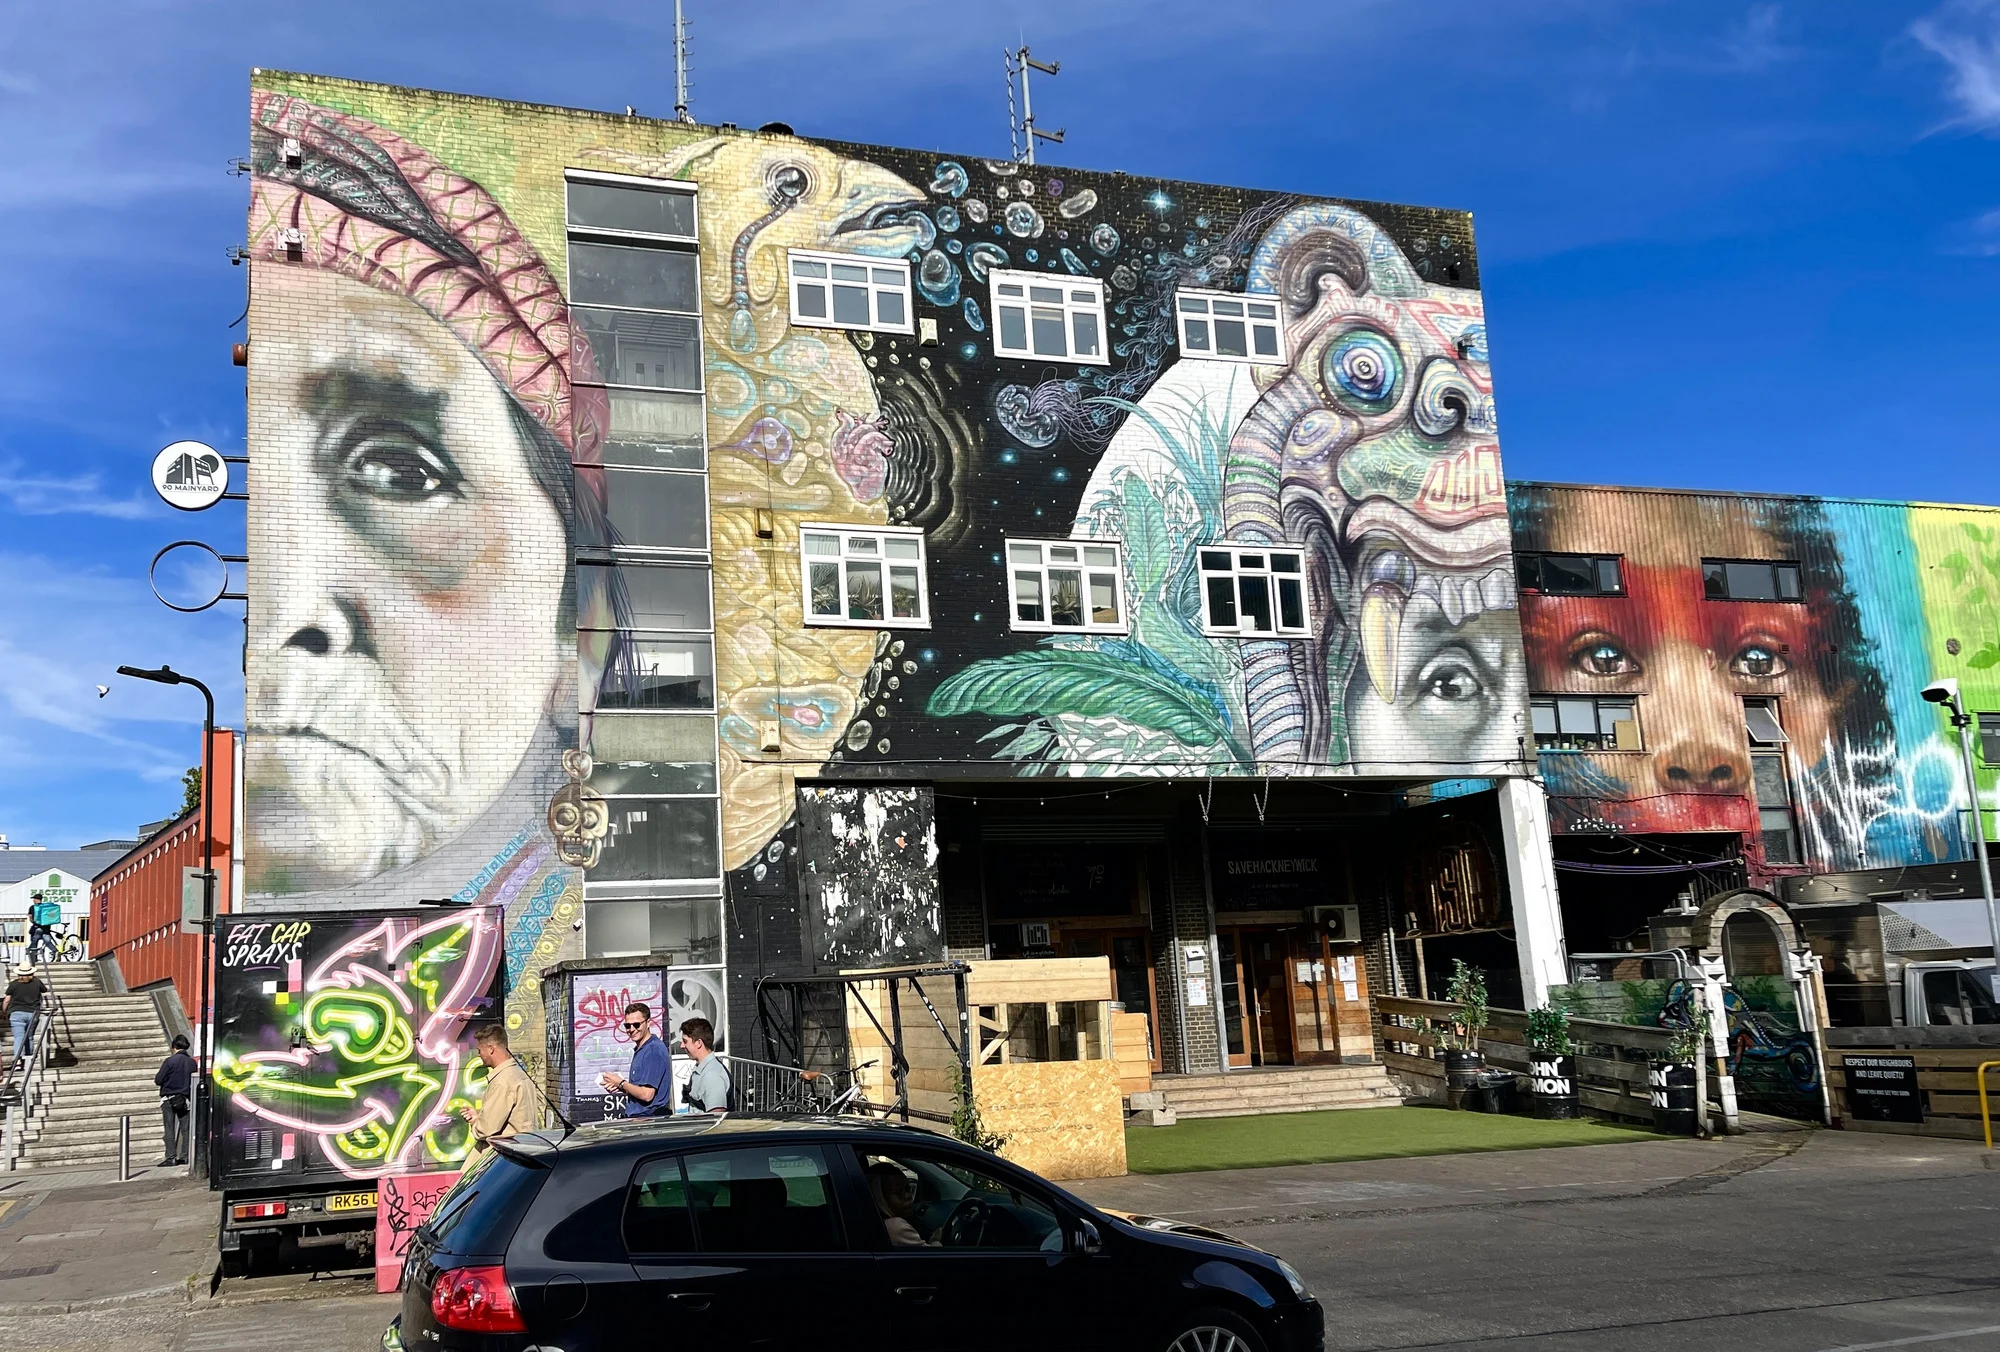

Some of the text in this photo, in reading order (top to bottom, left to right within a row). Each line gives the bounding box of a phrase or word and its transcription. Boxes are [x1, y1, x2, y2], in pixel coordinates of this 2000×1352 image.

[42, 895, 73, 903] RIDGE
[226, 921, 311, 945] FAT CAP
[222, 941, 302, 967] SPRAYS
[1844, 1058, 1867, 1067] RESPECT
[334, 1194, 369, 1208] RK56
